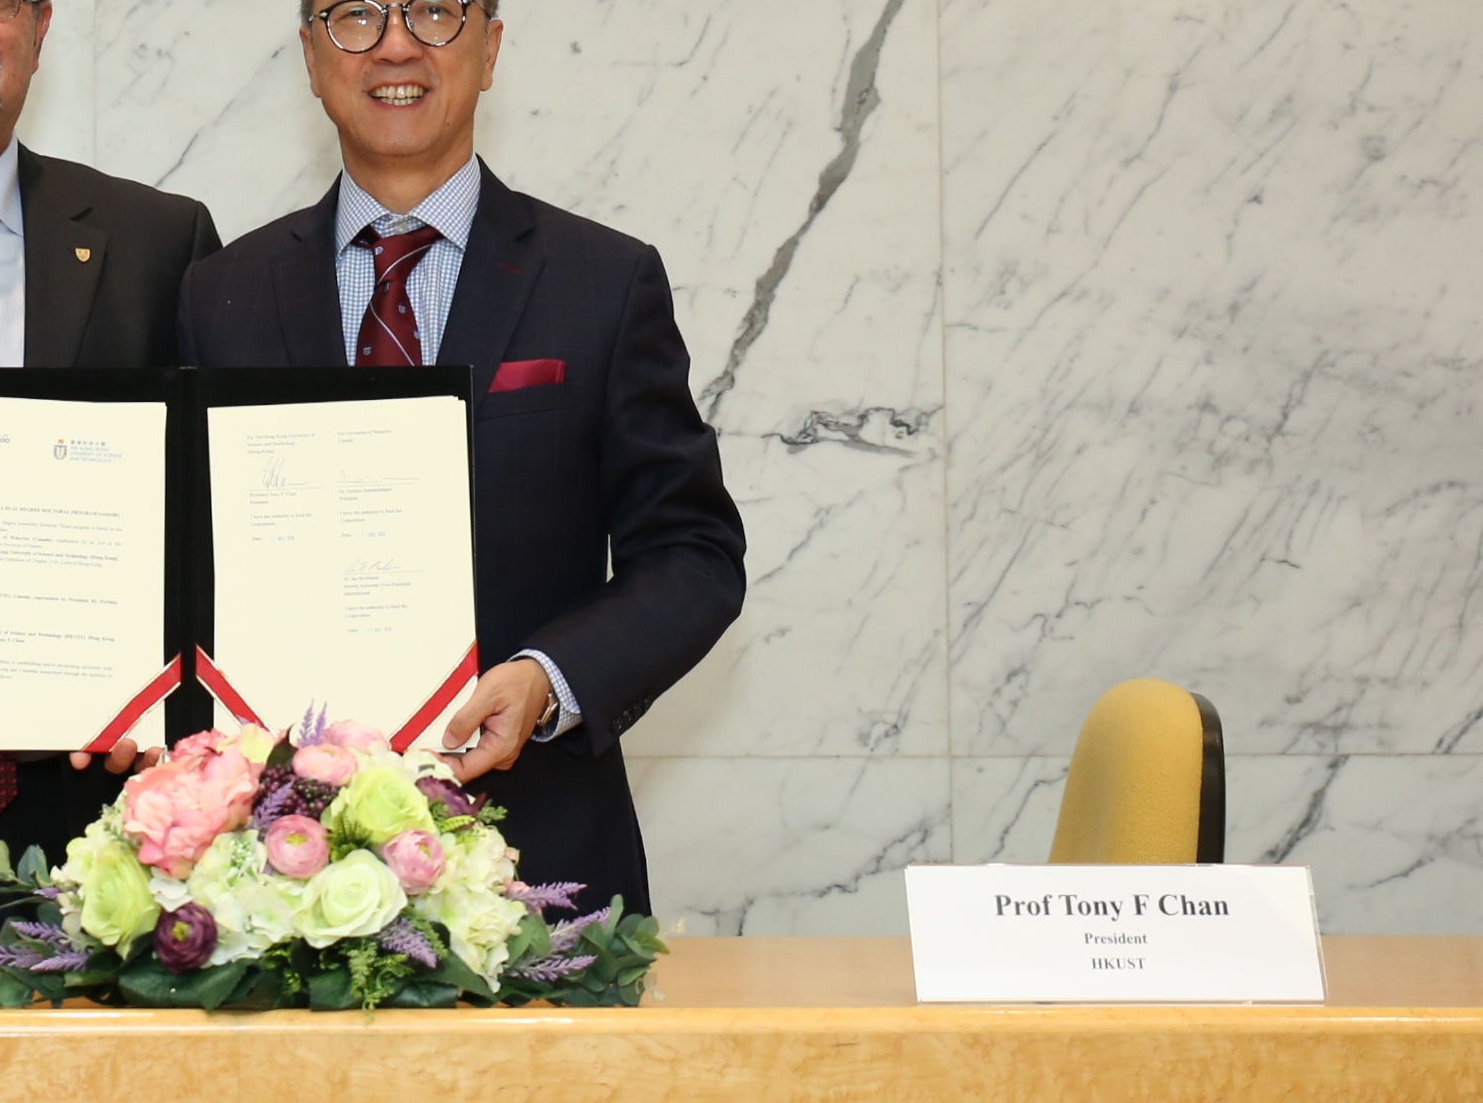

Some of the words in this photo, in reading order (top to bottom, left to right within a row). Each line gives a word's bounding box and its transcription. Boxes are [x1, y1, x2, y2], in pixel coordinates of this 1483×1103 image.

[994, 894, 1053, 916] Prof
[1058, 894, 1124, 922] Tony
[1132, 894, 1150, 916] F
[1157, 893, 1230, 916] Chan
[1083, 932, 1148, 945] President
[1090, 957, 1146, 970] HKUST
